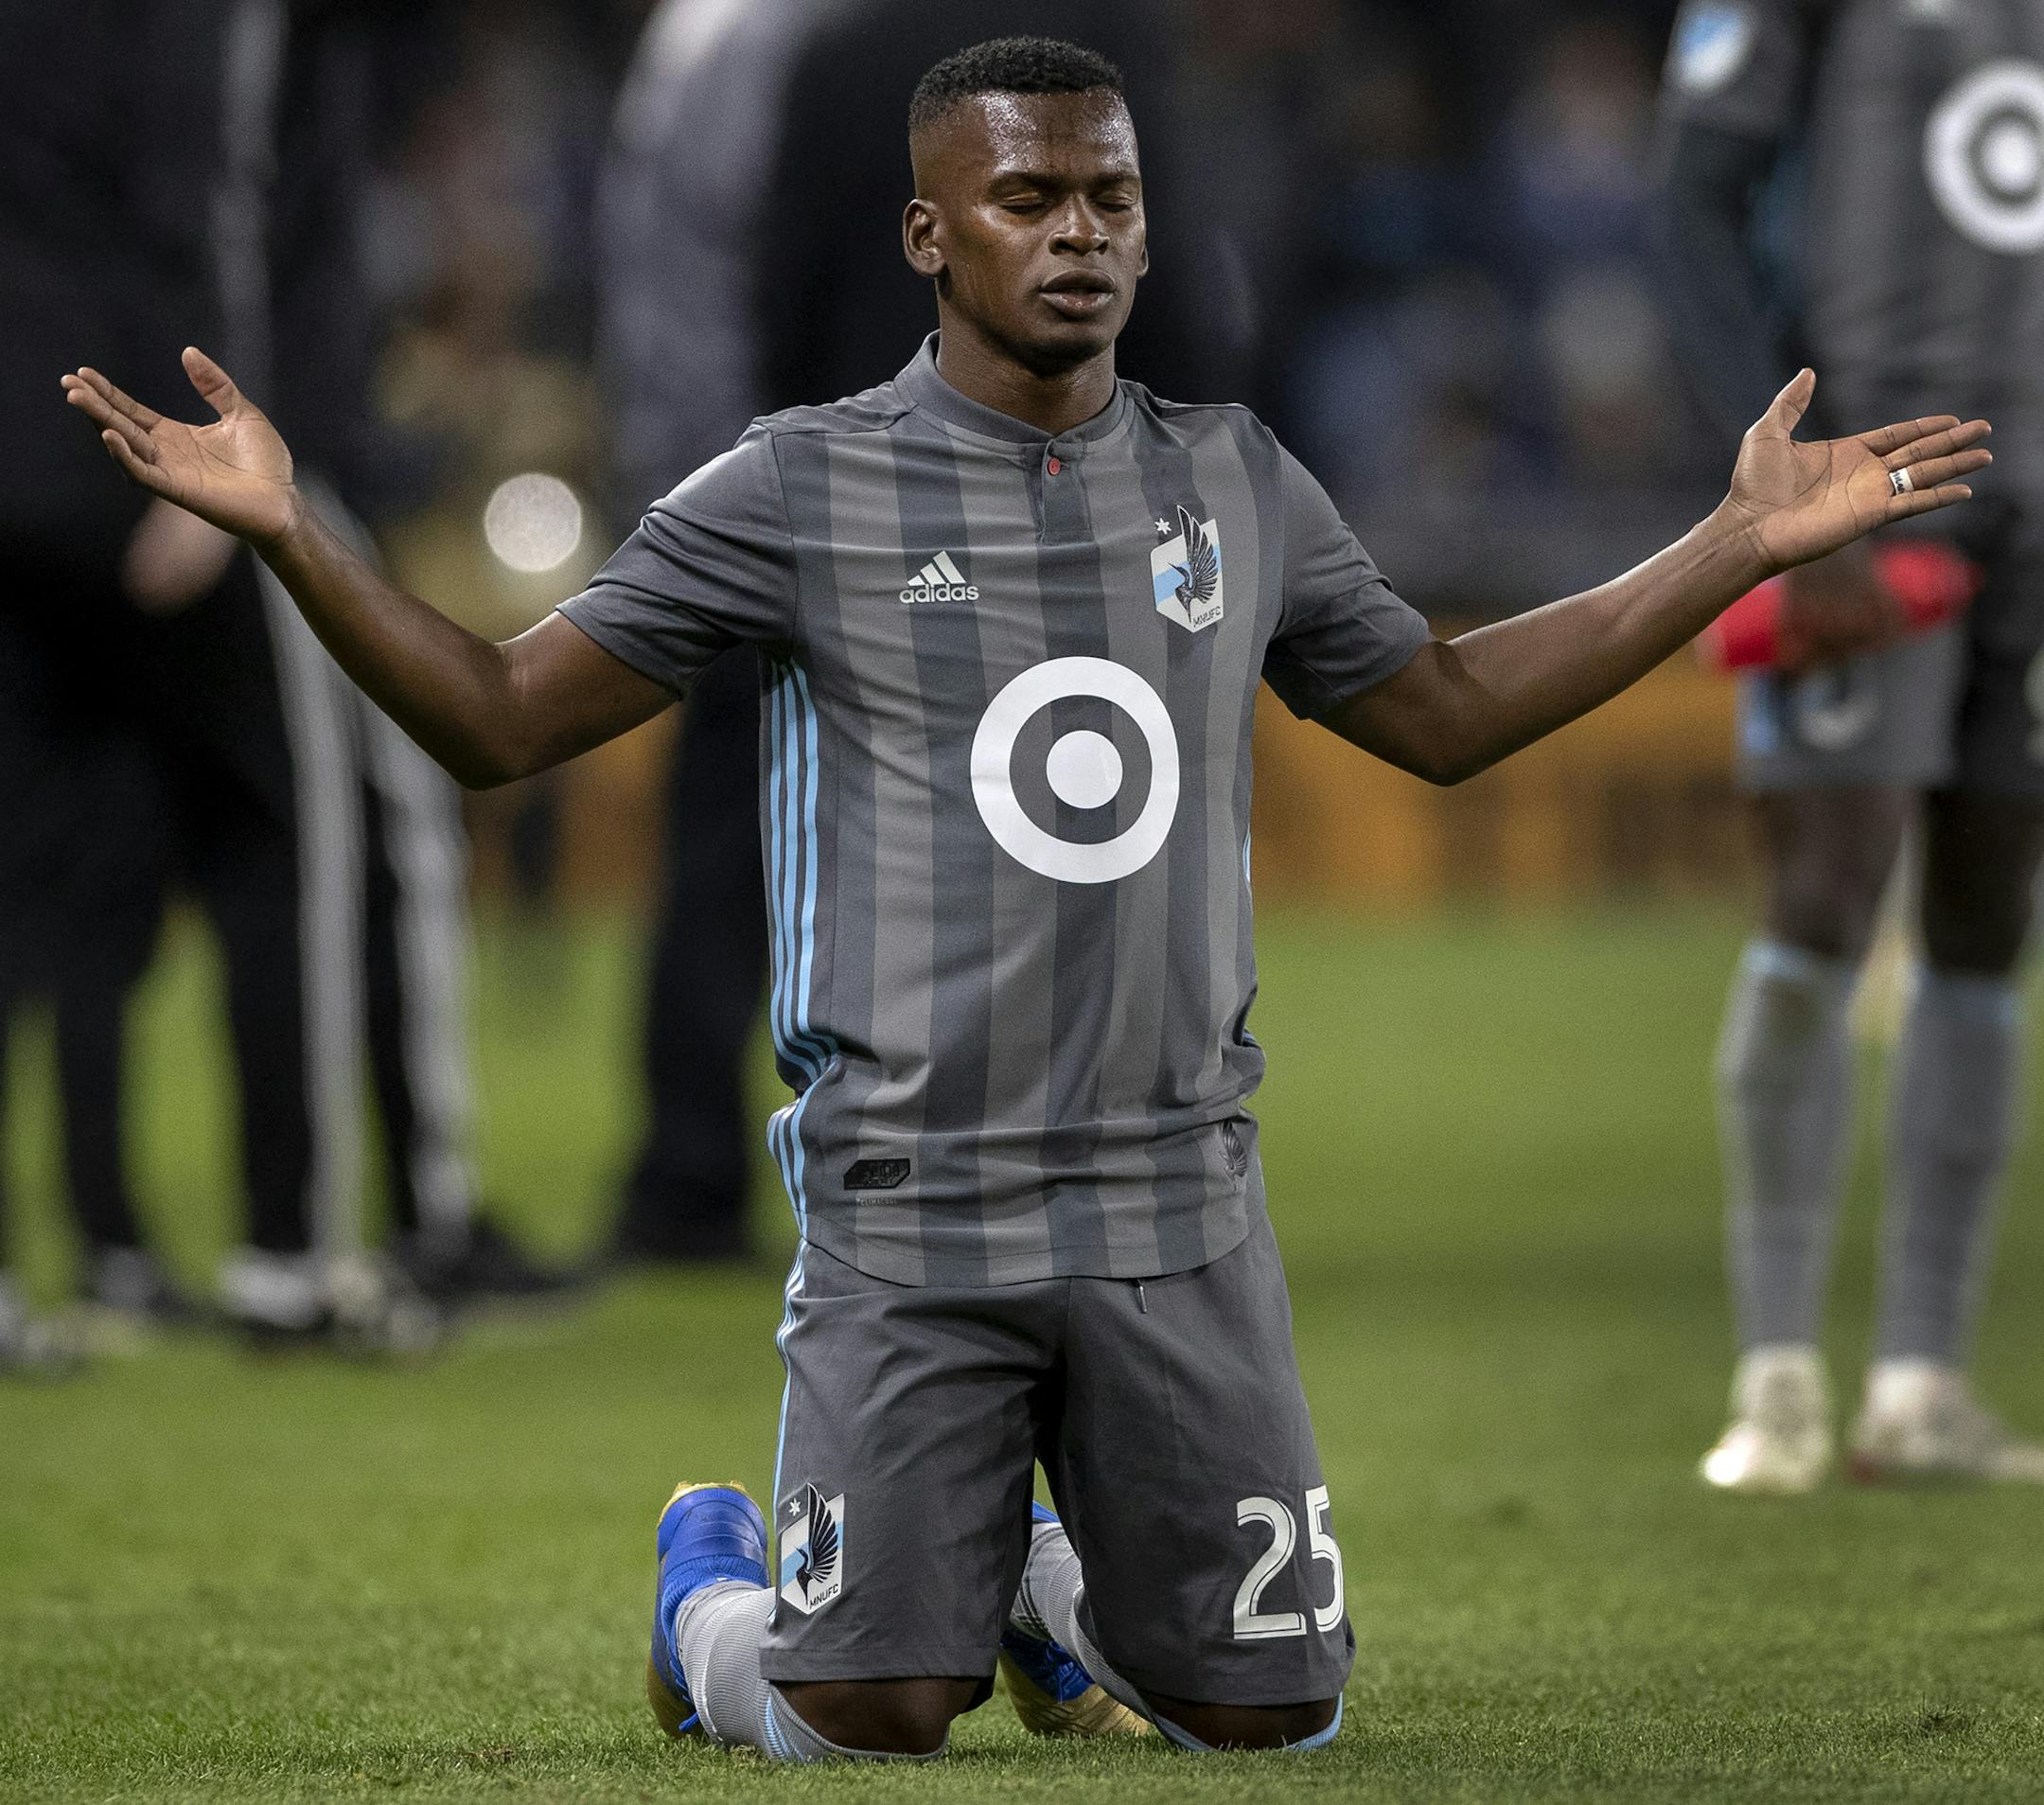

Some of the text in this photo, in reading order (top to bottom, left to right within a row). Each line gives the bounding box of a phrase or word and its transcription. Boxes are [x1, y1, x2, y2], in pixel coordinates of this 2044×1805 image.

[899, 584, 979, 603] adidas
[1192, 606, 1221, 628] MNUFC
[1233, 1484, 1344, 1639] 25
[809, 1584, 838, 1609] MNUFC
